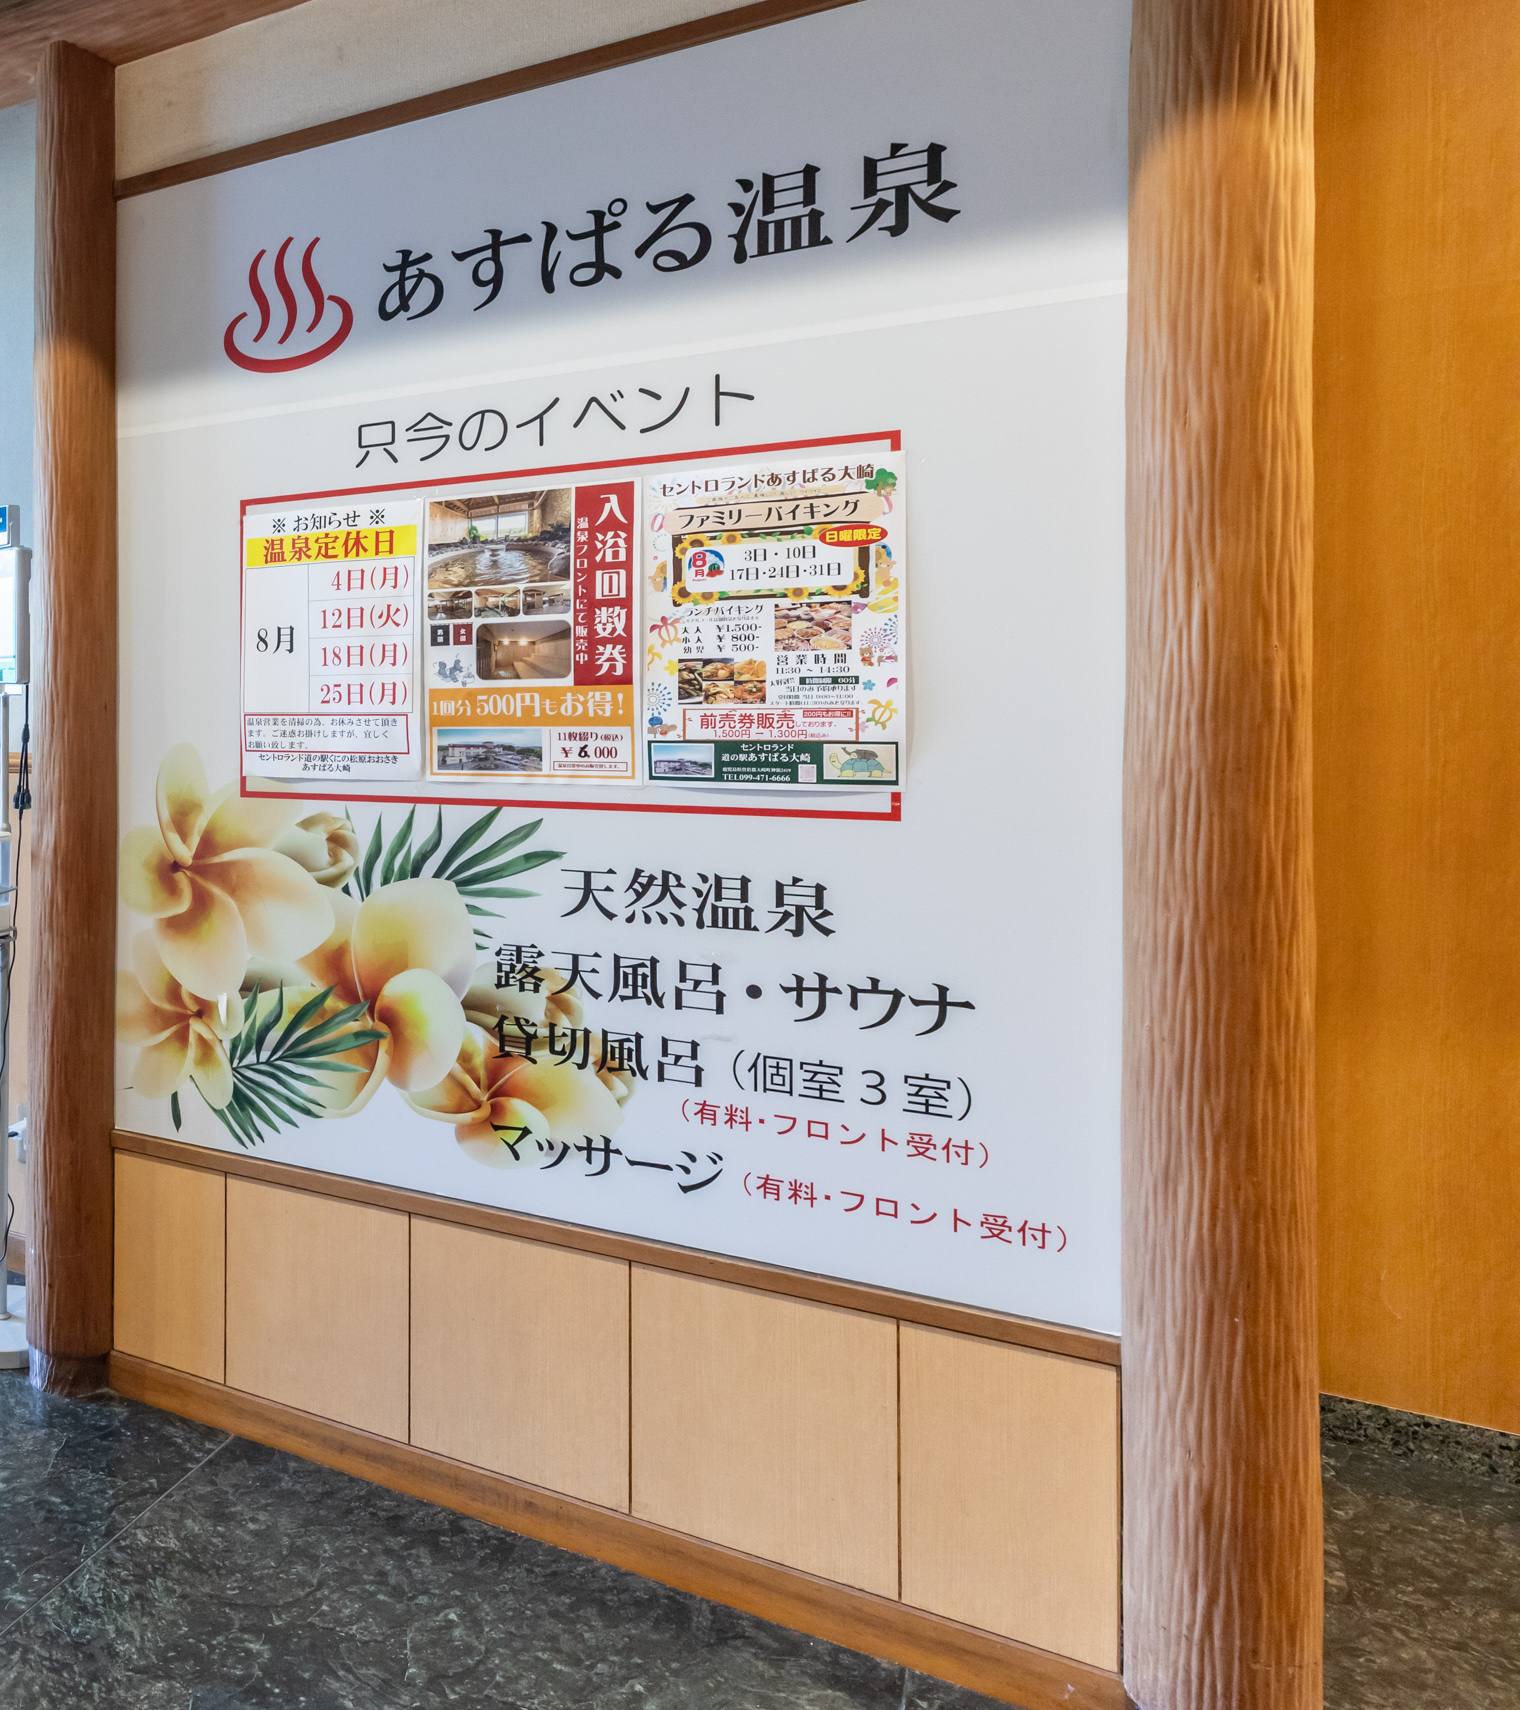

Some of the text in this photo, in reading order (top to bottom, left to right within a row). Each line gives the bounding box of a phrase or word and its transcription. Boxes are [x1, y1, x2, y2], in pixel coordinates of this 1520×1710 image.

[377, 141, 962, 324] あすぱる温泉
[355, 373, 755, 469] 只今のイベント
[660, 463, 875, 498] セントロランドあすぱる大崎
[292, 510, 361, 531] お知らせ
[678, 498, 860, 530] ファミリーバイキング
[263, 529, 395, 564] 温泉定休日
[825, 527, 882, 543] 日曜限定
[331, 564, 409, 591] 4日(月)
[575, 517, 589, 665] 温泉フロントにて販売中
[594, 493, 628, 677] 入浴回数券
[320, 603, 409, 630] 12日(火)
[256, 625, 295, 654] 8月
[320, 642, 409, 668] 18日(月)
[776, 653, 847, 666] 営業時間
[320, 680, 408, 706] 25日(月)
[721, 752, 811, 763] 道の駅あすぱる大崎
[741, 743, 794, 752] セントロランド
[560, 867, 836, 938] 天然温泉
[493, 942, 976, 1037] 露天風呂・サウナ
[490, 1120, 724, 1195] マッサージ
